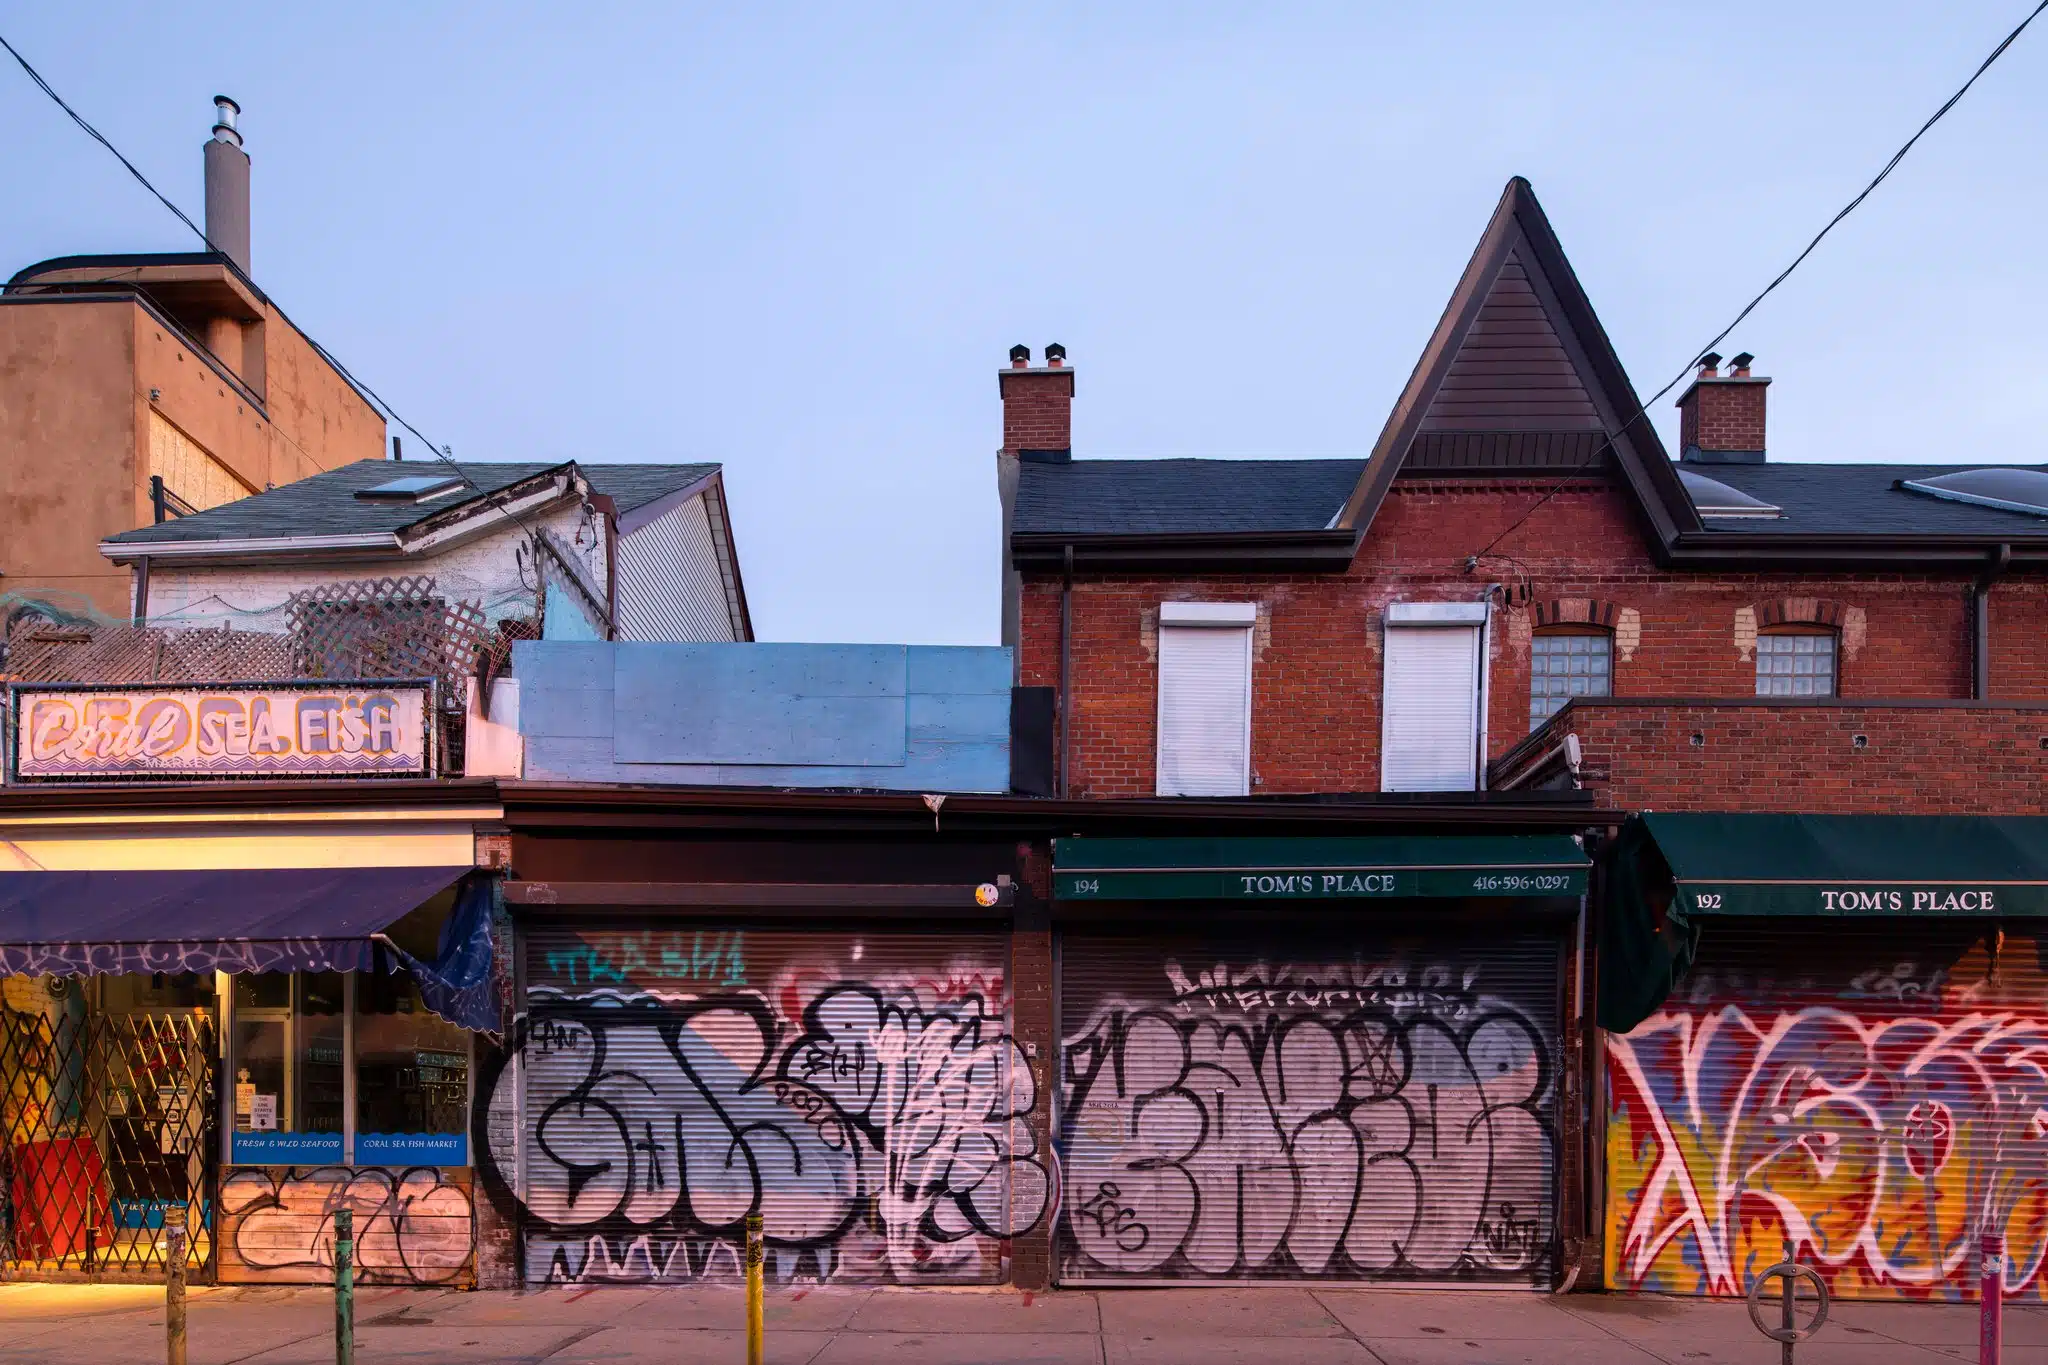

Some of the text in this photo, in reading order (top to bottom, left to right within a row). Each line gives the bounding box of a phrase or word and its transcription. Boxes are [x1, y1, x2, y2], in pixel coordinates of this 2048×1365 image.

[31, 704, 401, 761] Coral SEA FISH
[1073, 879, 1099, 893] 194
[1241, 875, 1395, 893] TOM'S PLACE
[1696, 894, 1722, 909] 192
[1821, 891, 1995, 910] TOM'S PLACE
[237, 1140, 265, 1148] FRESH
[269, 1140, 275, 1148] &
[300, 1140, 340, 1148] SEAFOOD
[363, 1139, 458, 1148] CORAL SEA FISH MARKET
